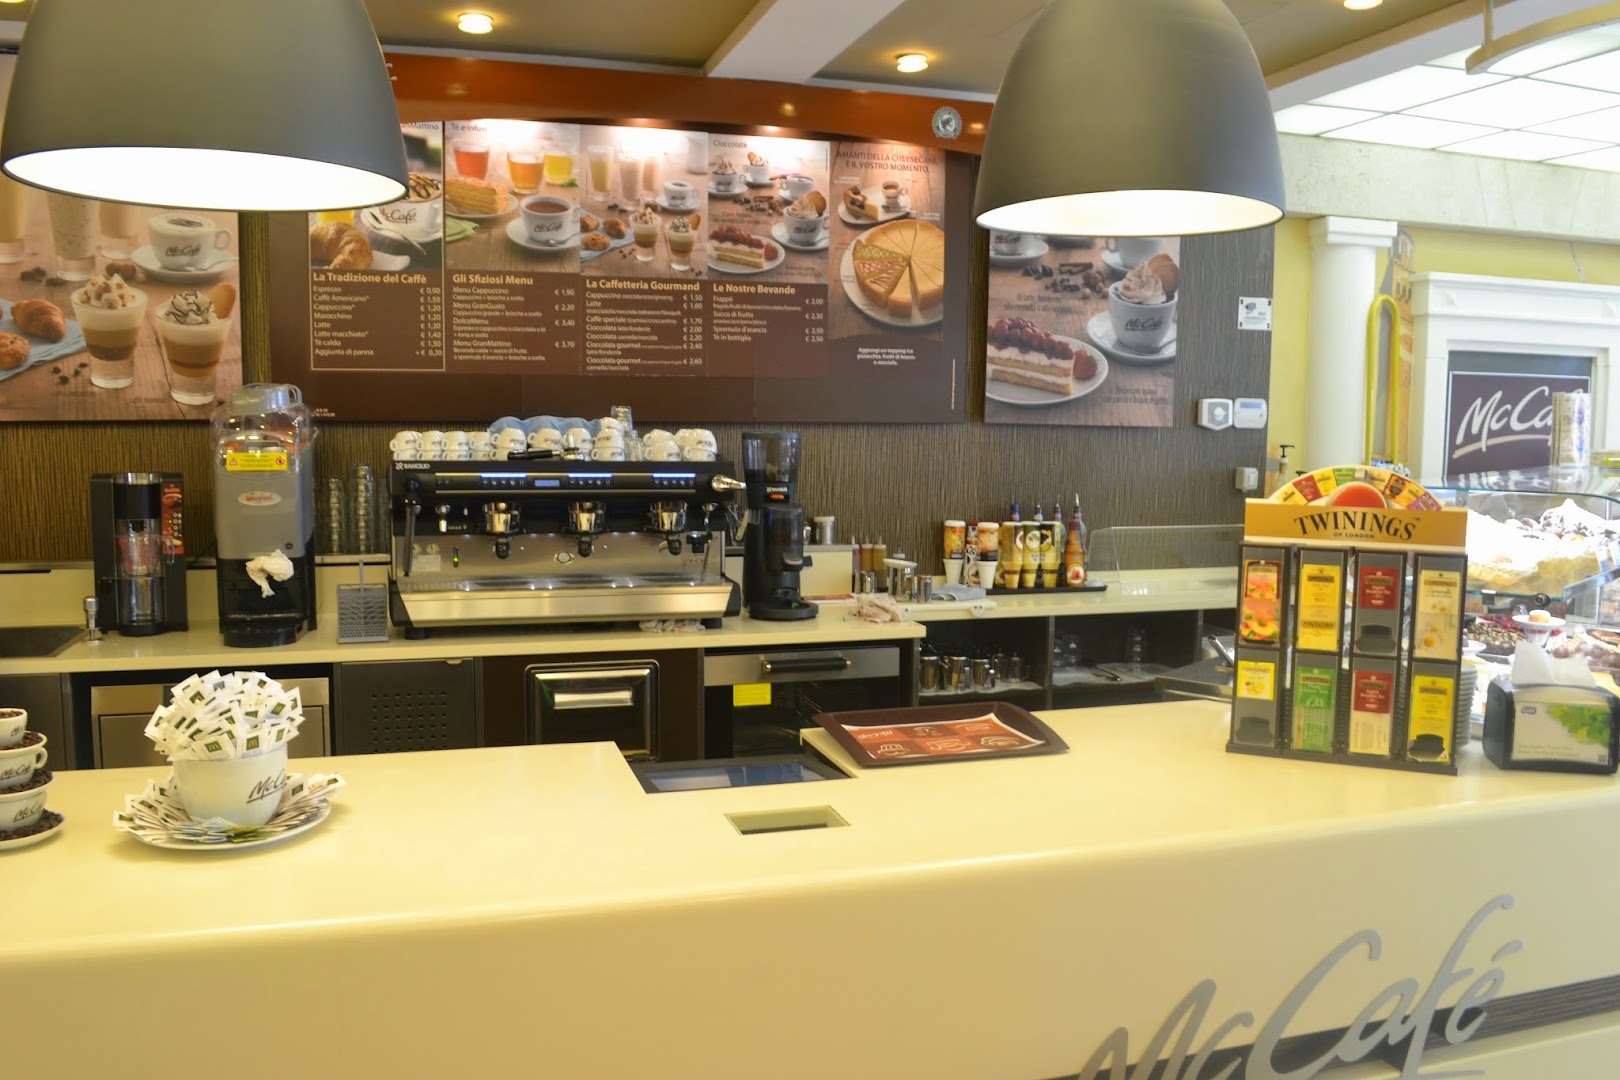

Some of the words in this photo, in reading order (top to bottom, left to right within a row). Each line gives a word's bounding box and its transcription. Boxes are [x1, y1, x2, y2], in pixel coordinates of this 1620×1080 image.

[713, 139, 748, 148] Cioccolate
[837, 151, 866, 159] AMANTI
[866, 153, 890, 161] DELLA
[313, 273, 324, 281] La
[327, 273, 380, 282] Tradizione
[383, 274, 399, 283] del
[401, 274, 427, 284] Caffè
[452, 274, 466, 283] Gli
[469, 274, 504, 284] Sfiziosi
[505, 275, 533, 285] Menu
[586, 279, 597, 288] La
[599, 280, 648, 289] Caffetteria
[650, 280, 700, 291] Gourmand
[713, 284, 724, 292] Le
[726, 284, 755, 293] Nostre
[757, 285, 796, 295] Bevande
[561, 288, 574, 296] 1,90
[586, 292, 621, 300] Cappuccino
[314, 312, 352, 320] Marocchino
[1124, 316, 1162, 331] McCafé
[713, 326, 741, 334] Spremuta
[561, 341, 575, 349] 3,70
[617, 342, 641, 350] gourmet
[314, 348, 344, 357] Aggiunta
[1455, 385, 1552, 453] McCa
[403, 462, 430, 470] RANCILIO
[1293, 510, 1416, 541] TWININGS
[1073, 892, 1525, 1080] McCafé
